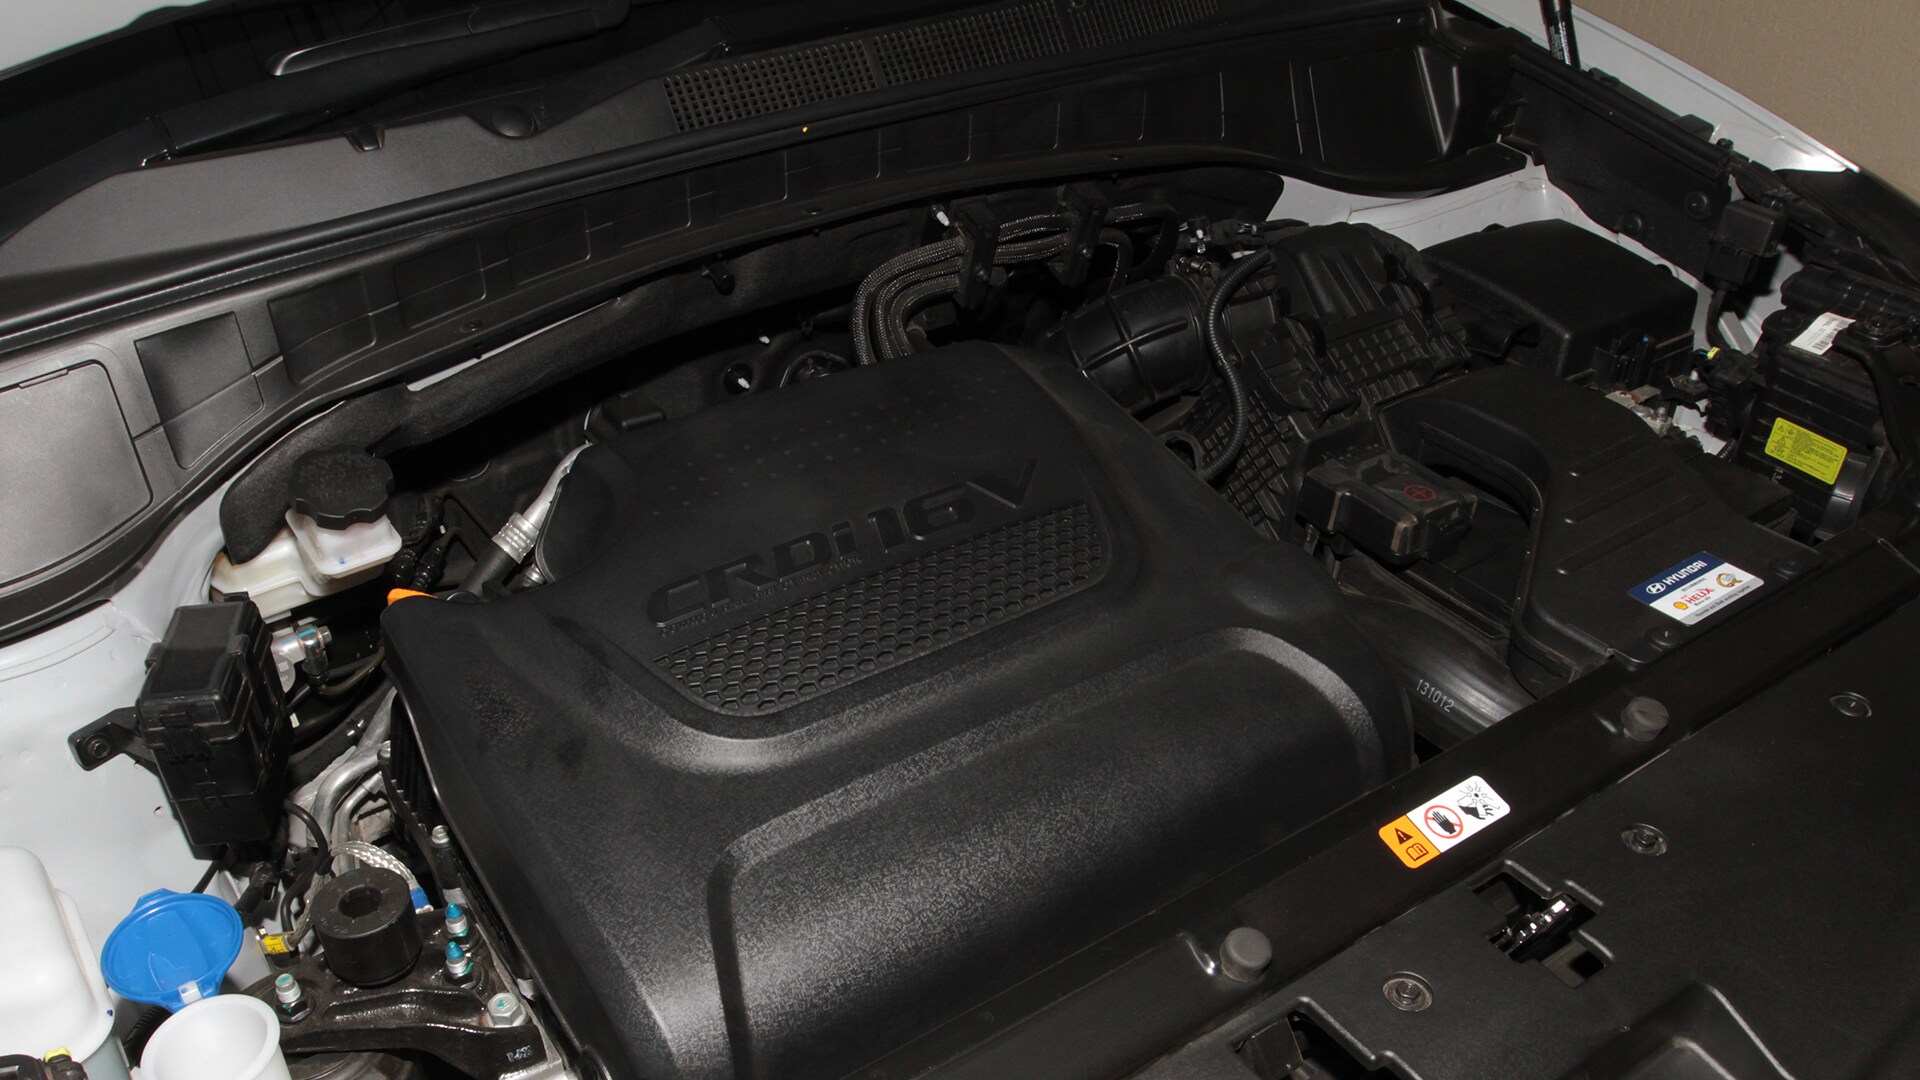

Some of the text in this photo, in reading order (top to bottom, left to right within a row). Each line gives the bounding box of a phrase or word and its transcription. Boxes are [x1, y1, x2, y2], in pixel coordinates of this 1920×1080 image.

[1662, 560, 1708, 586] HYUNDAI
[1685, 587, 1715, 604] HELIX
[1416, 679, 1455, 713] 131012
